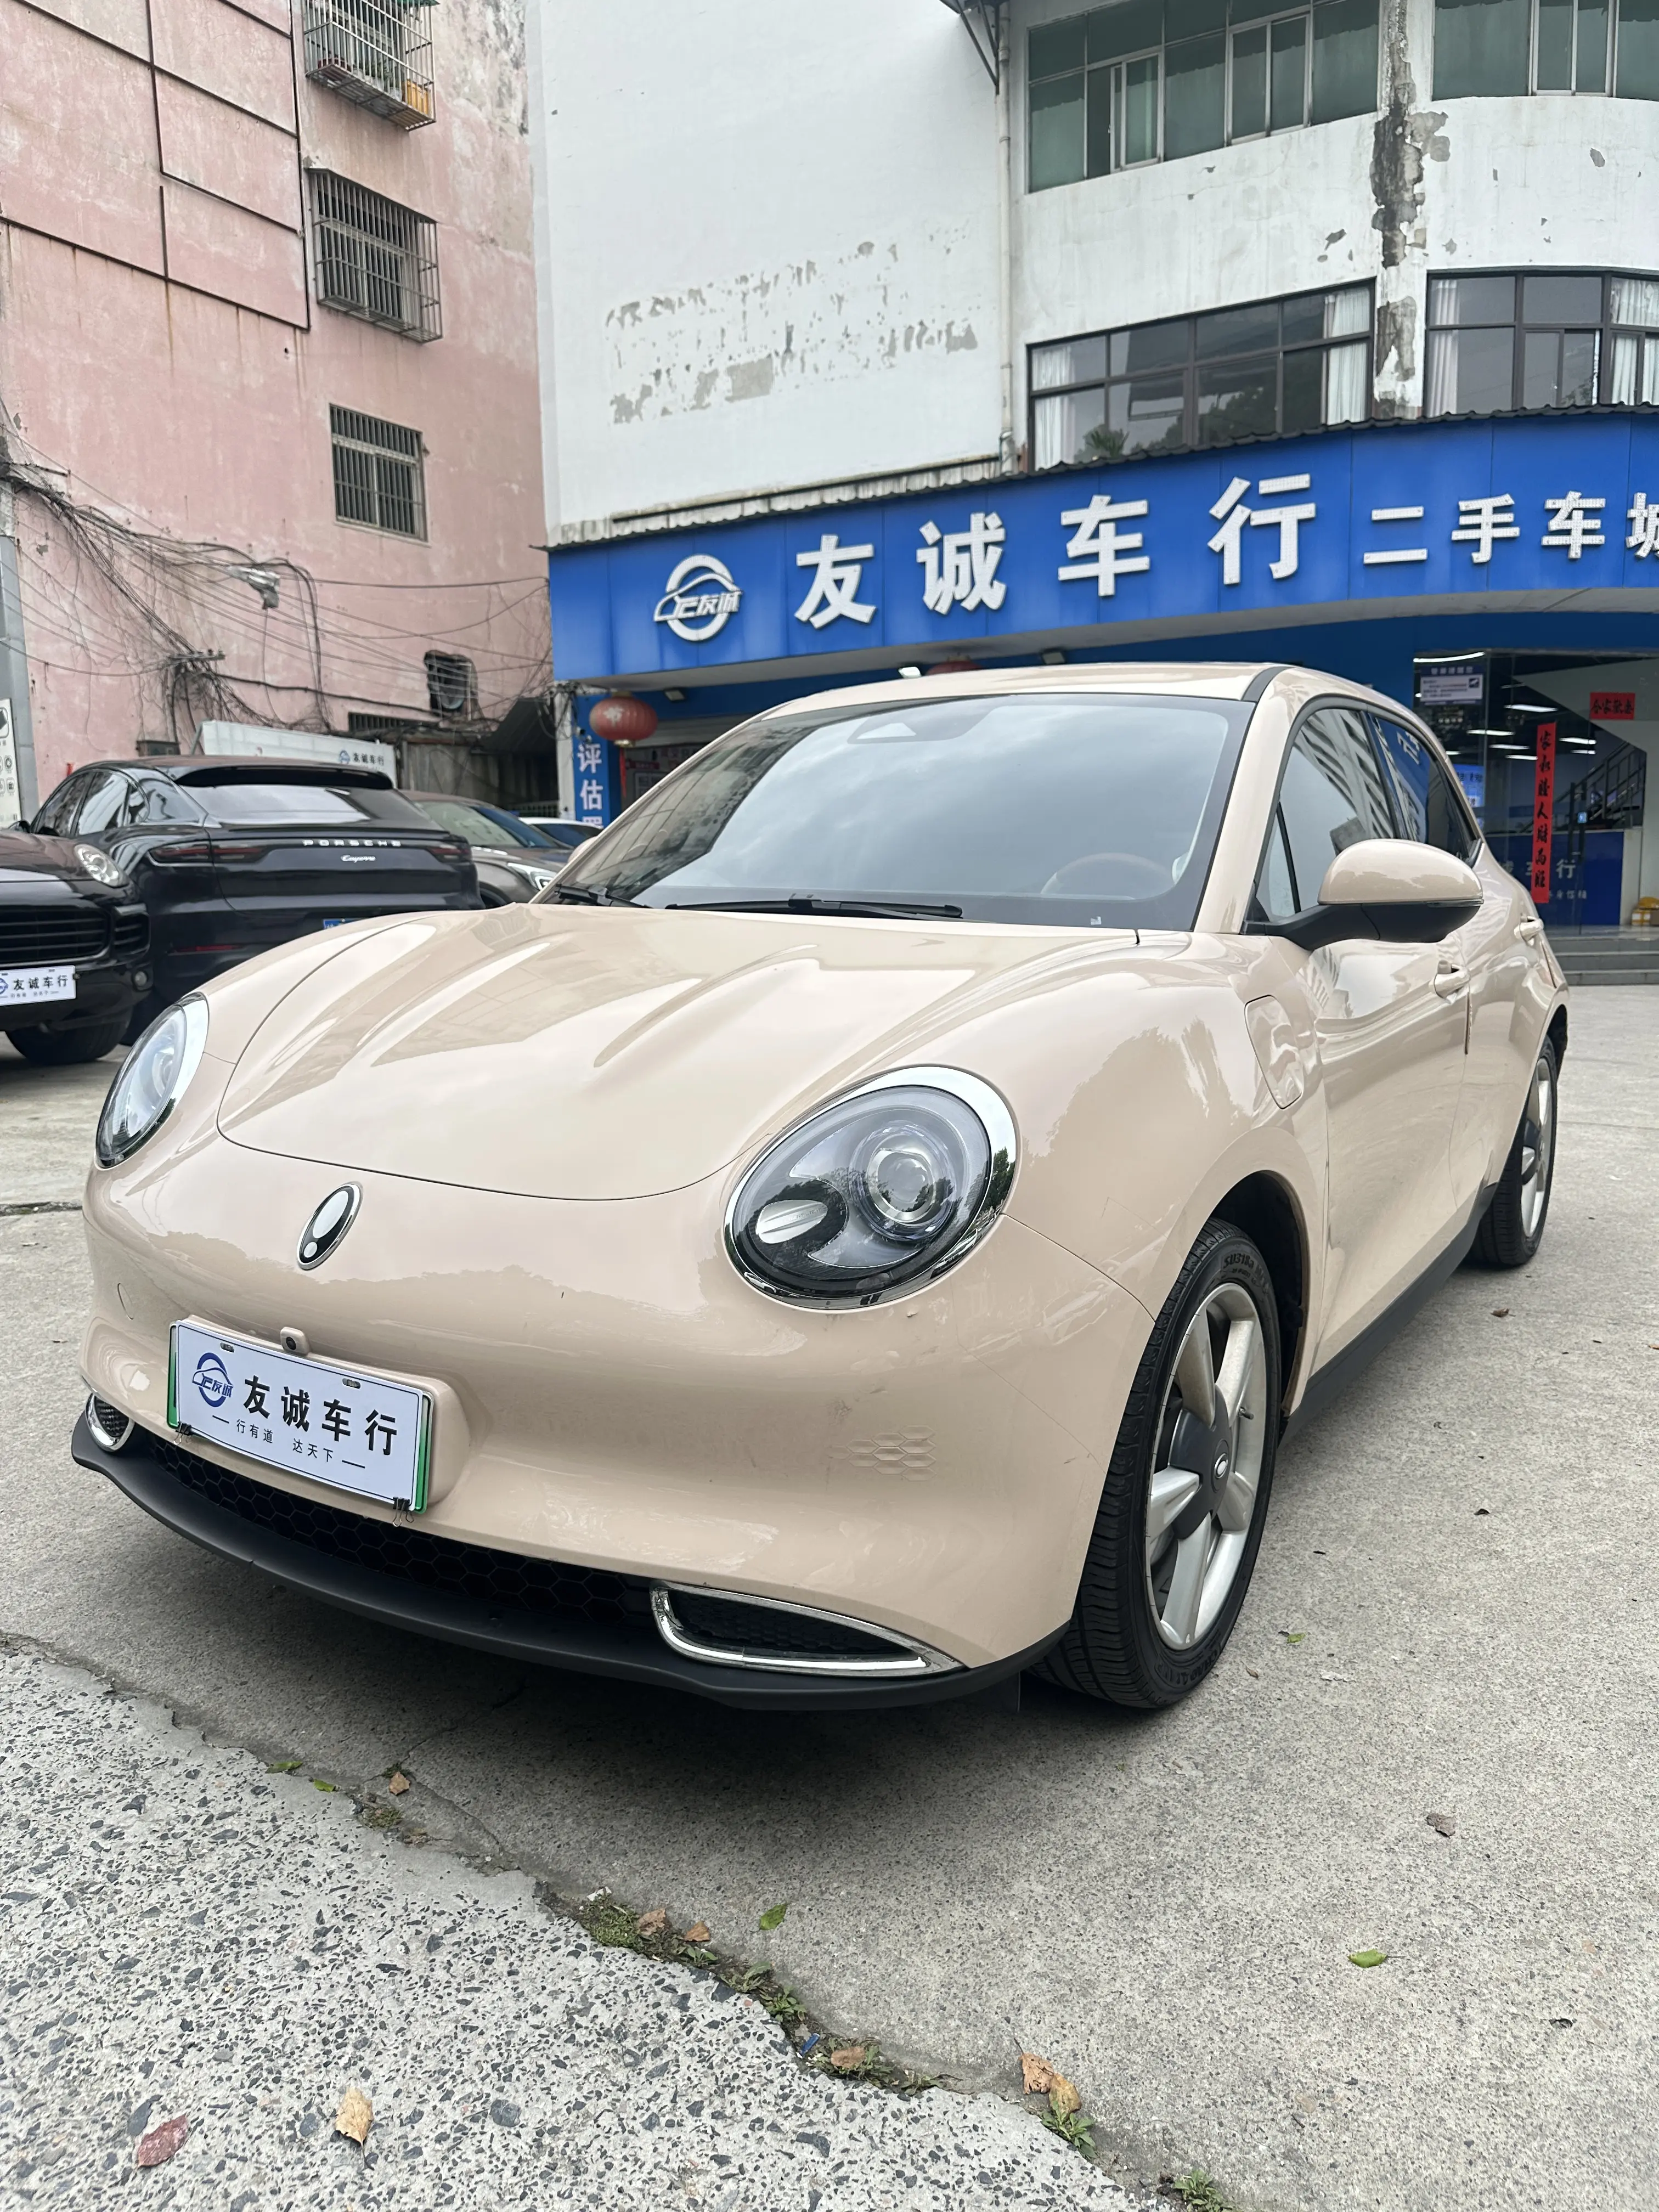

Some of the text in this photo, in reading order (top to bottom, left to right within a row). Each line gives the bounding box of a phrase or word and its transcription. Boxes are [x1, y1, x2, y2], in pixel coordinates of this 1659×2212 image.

[794, 473, 1317, 629] 友诚车行
[302, 839, 402, 847] PORSCHE
[13, 975, 68, 991] 友诚车行
[244, 1375, 398, 1456] 友诚车行
[236, 1418, 334, 1463] 行有道 达天下
